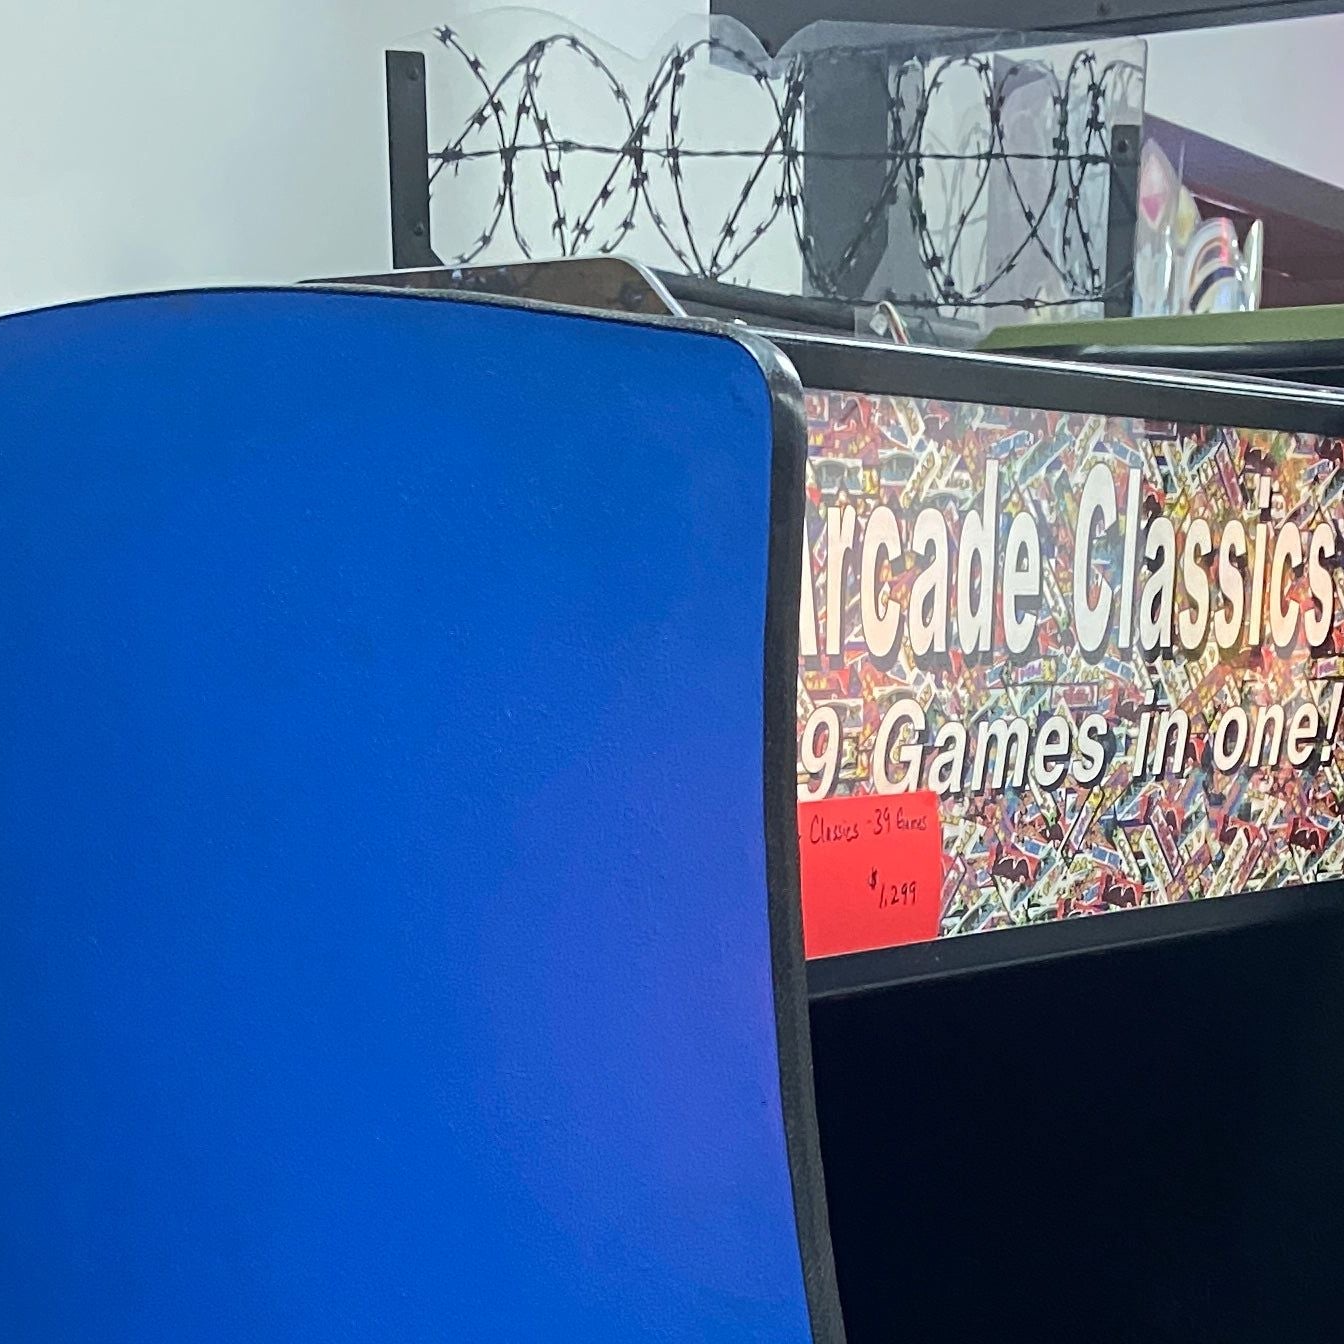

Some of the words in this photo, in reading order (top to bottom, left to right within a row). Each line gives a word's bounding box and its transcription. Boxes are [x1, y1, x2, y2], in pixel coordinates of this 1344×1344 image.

[1073, 463, 1337, 652] Classics
[873, 697, 1109, 796] Games
[1133, 690, 1189, 778] in
[1213, 682, 1344, 772] one!
